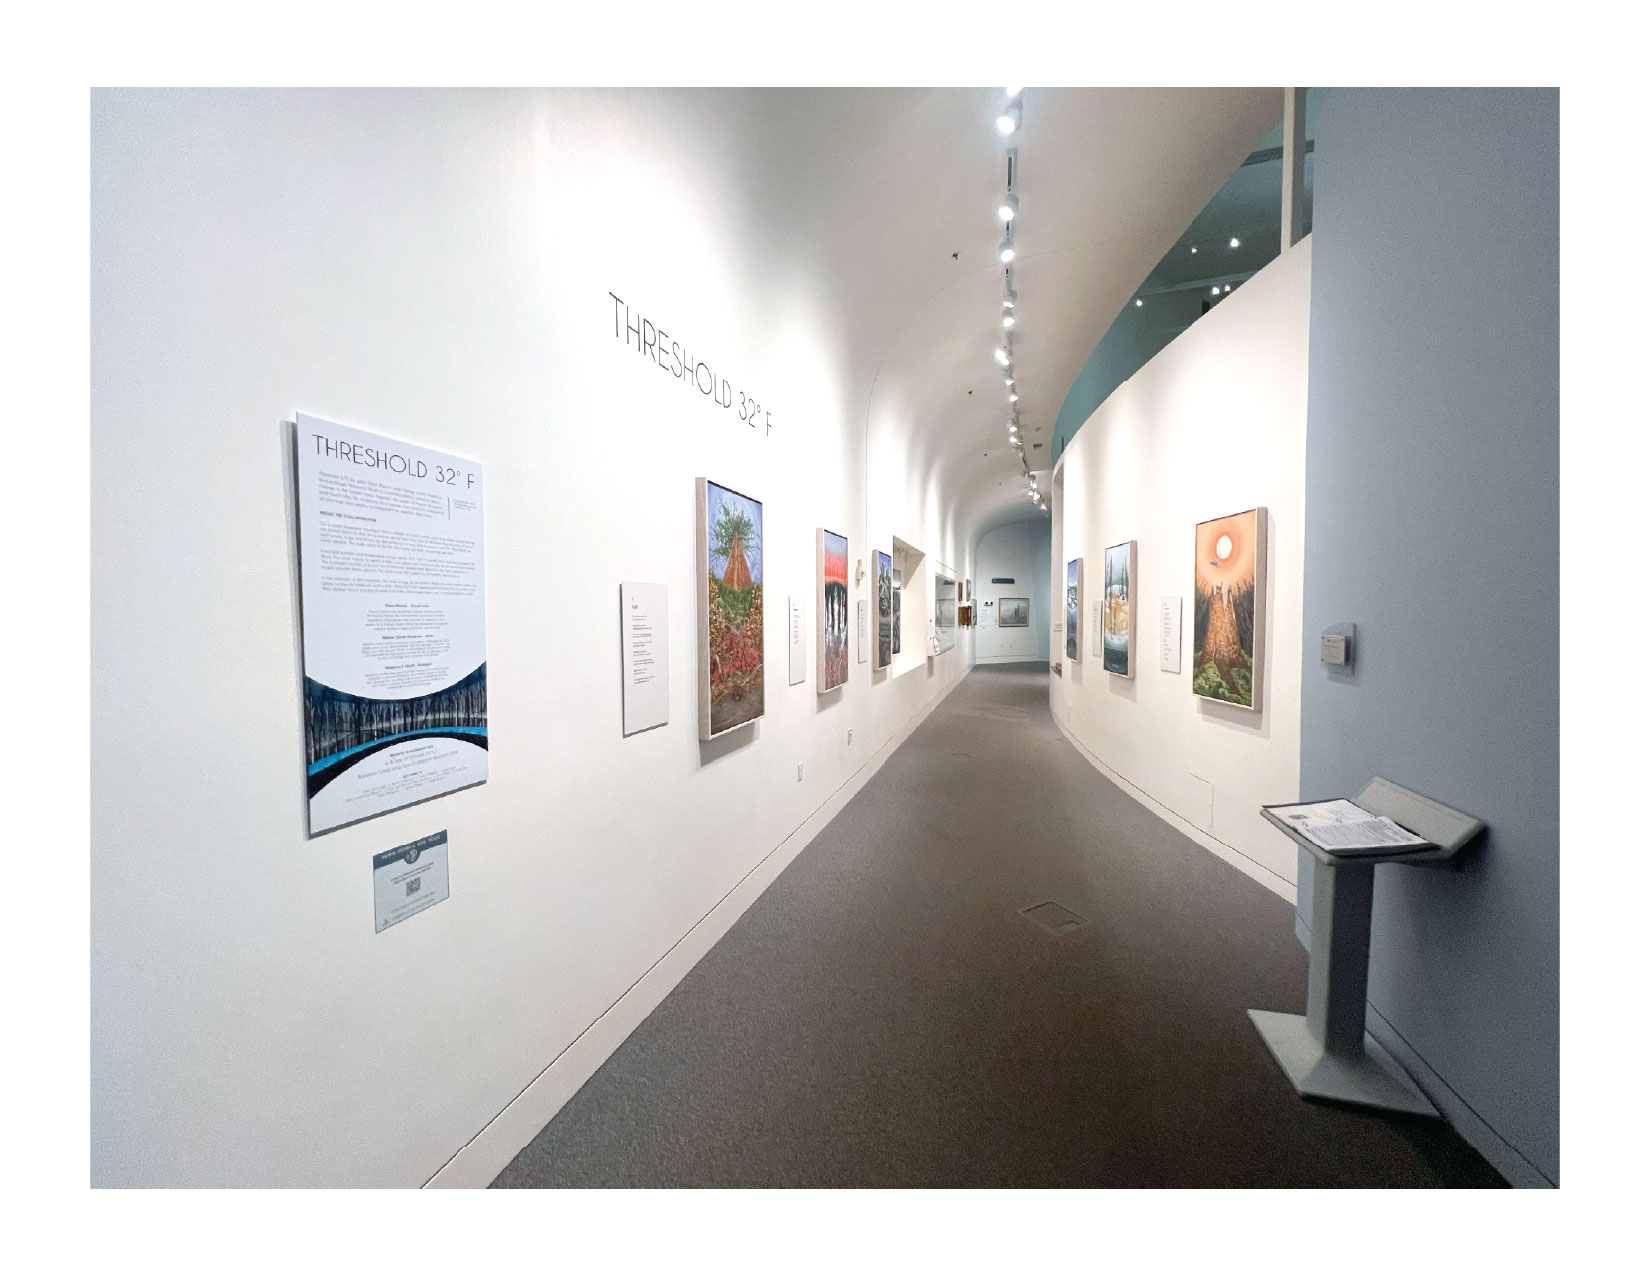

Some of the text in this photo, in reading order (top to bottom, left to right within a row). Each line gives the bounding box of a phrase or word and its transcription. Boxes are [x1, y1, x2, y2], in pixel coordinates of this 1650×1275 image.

[609, 292, 772, 437] THRESHOLD 32° F
[312, 434, 475, 489] THRESHOLD 32° F
